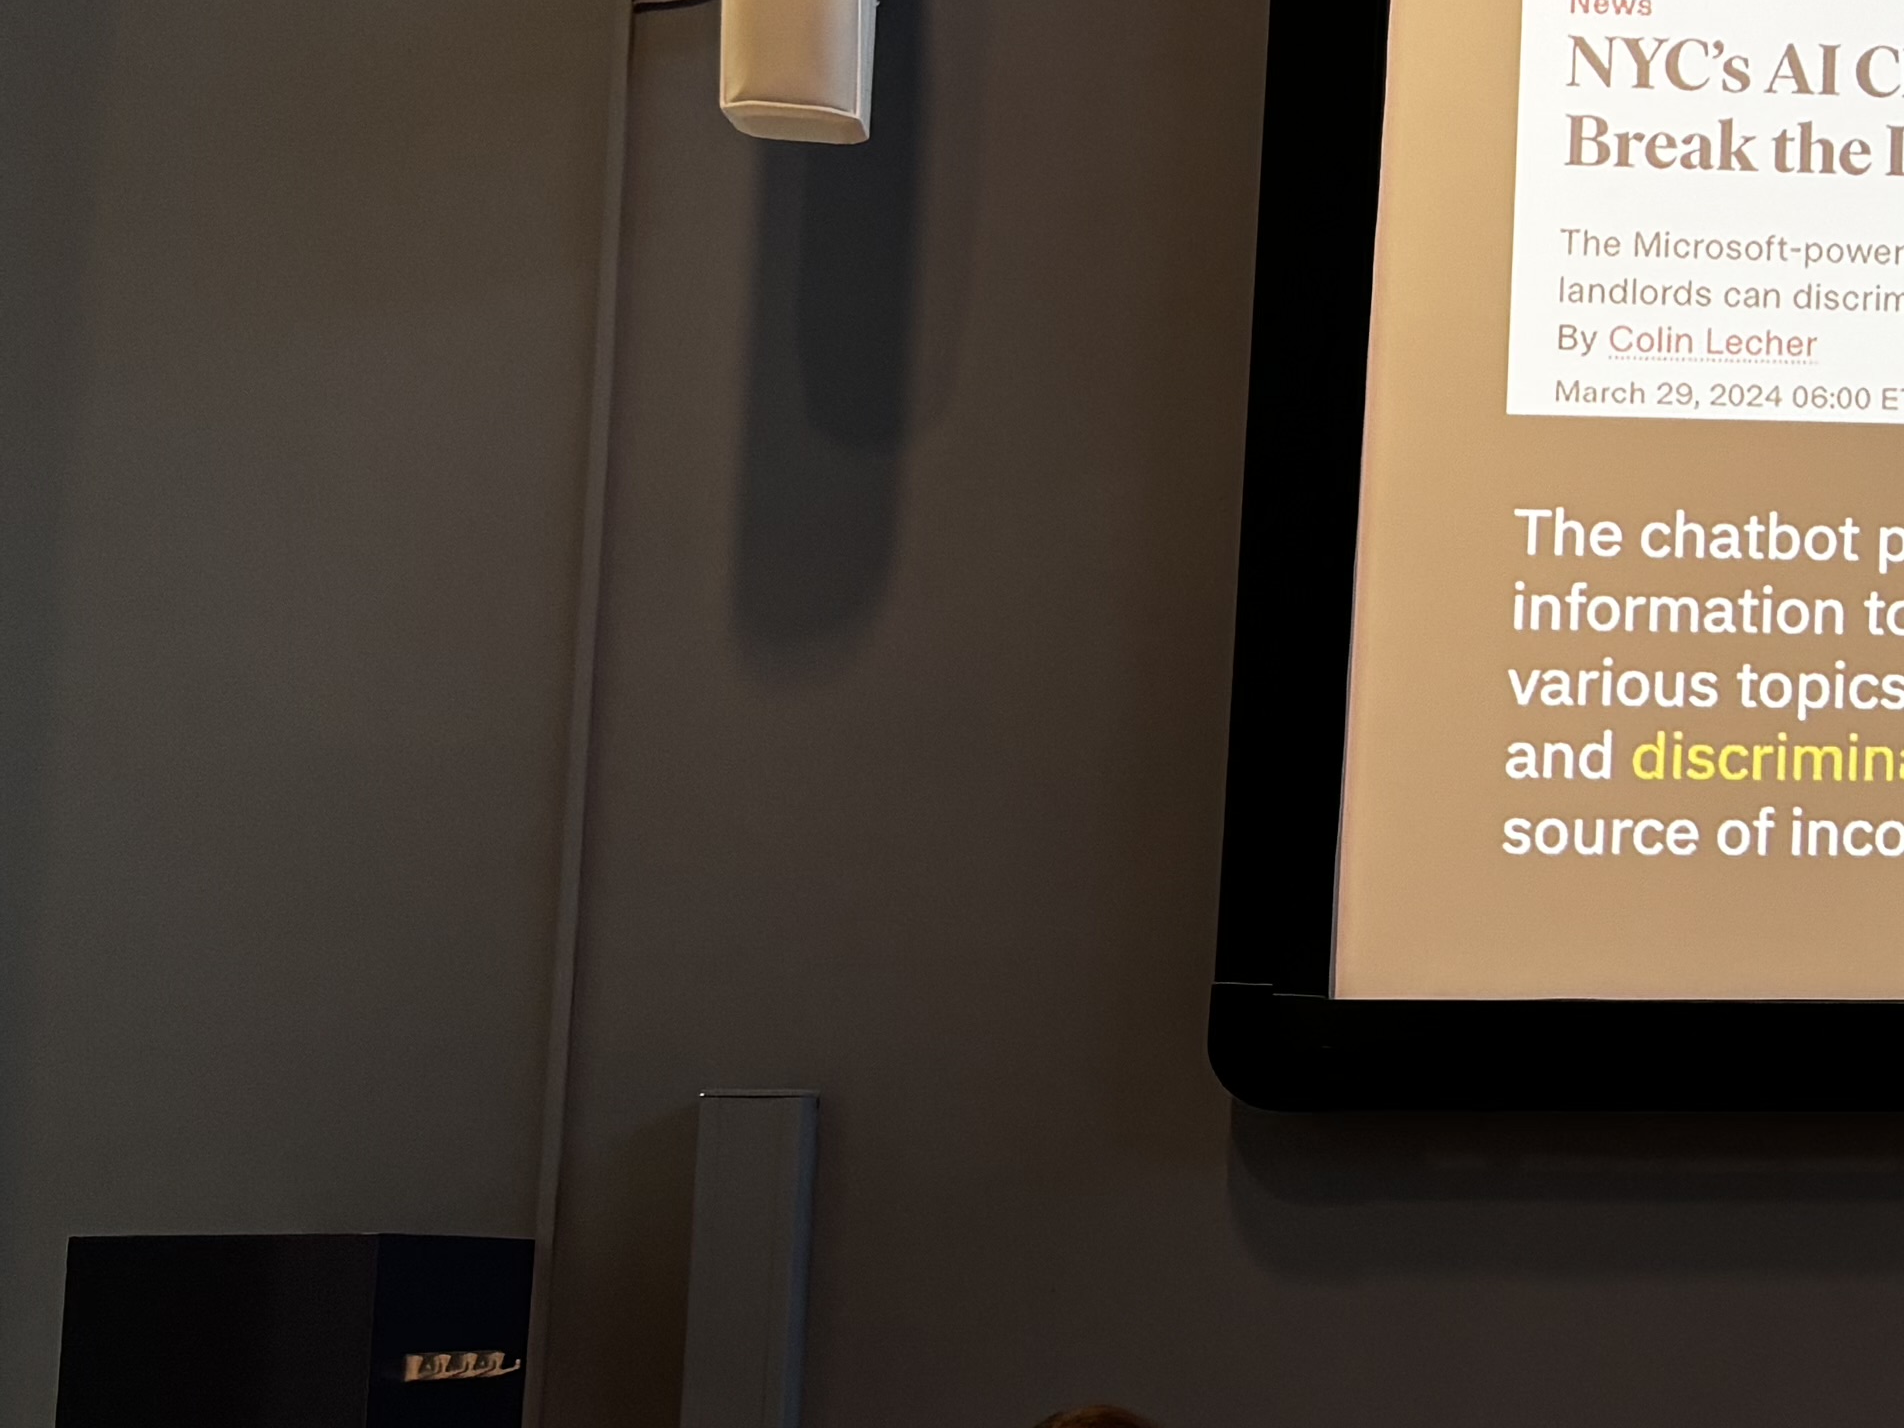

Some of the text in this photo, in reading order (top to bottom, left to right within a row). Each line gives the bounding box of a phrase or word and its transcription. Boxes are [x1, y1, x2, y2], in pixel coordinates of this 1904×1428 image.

[1764, 43, 1840, 95] AI
[1565, 114, 1758, 171] Break
[1772, 121, 1872, 176] the
[1558, 324, 1818, 360] By Colin Lecher
[1556, 380, 1645, 404] March
[1657, 382, 1699, 410] 29,
[1710, 383, 1782, 407] 2024
[1793, 385, 1871, 410] 06:00
[1514, 507, 1622, 557] The
[1641, 509, 1860, 561] chatbot
